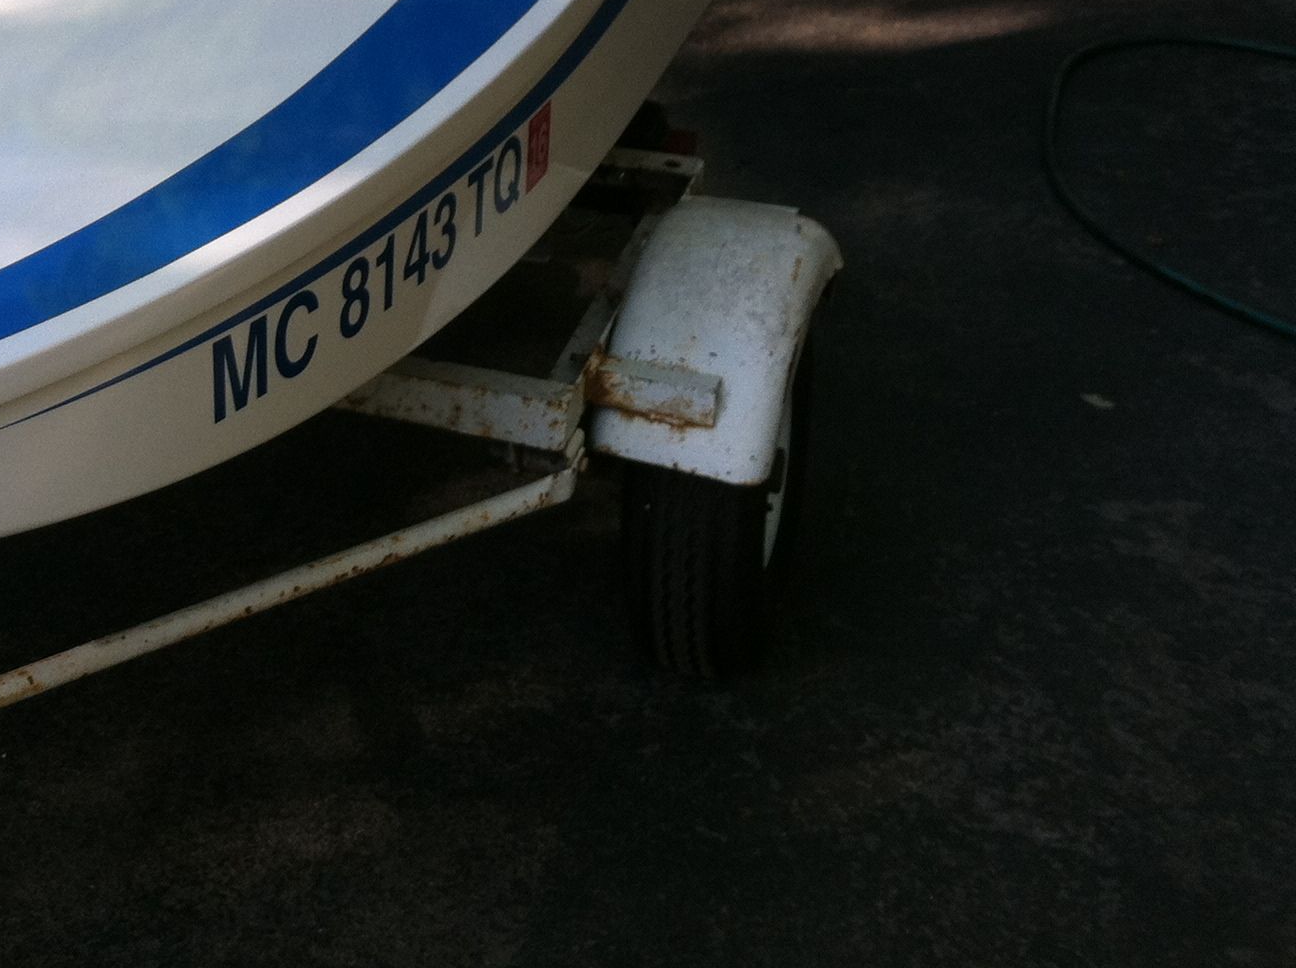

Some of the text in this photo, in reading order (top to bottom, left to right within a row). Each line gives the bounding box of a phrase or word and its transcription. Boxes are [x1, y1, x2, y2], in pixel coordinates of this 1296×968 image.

[212, 288, 320, 425] MC
[338, 190, 458, 340] 8143
[467, 136, 523, 238] TQ
